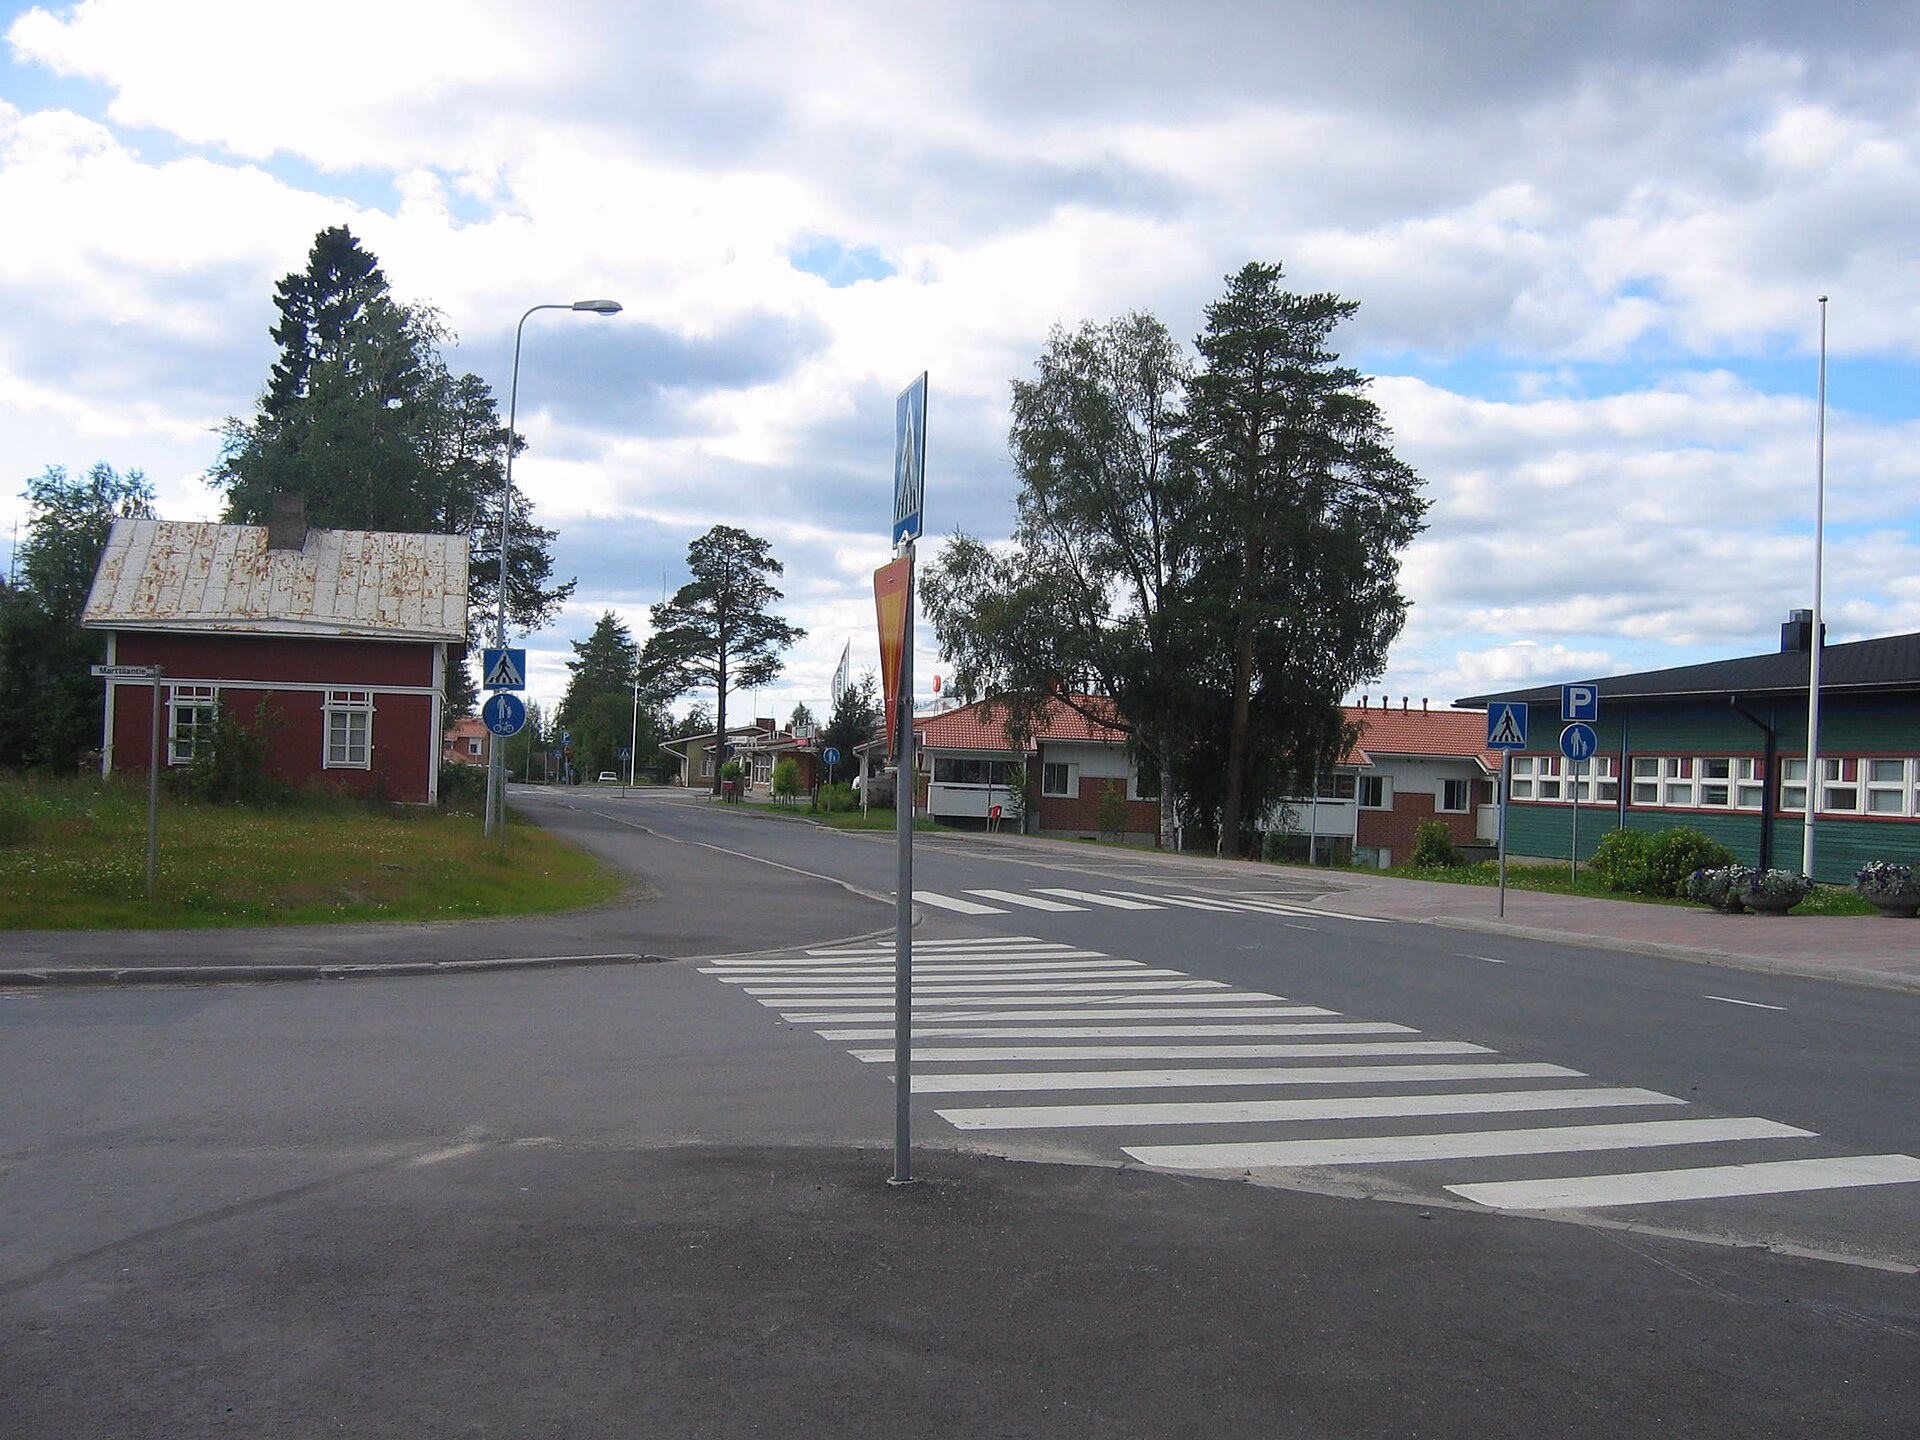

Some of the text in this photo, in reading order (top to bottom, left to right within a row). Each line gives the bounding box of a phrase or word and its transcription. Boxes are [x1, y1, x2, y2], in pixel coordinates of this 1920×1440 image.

[99, 666, 147, 675] Marttilantie
[1569, 687, 1592, 717] P
[563, 731, 570, 741] P
